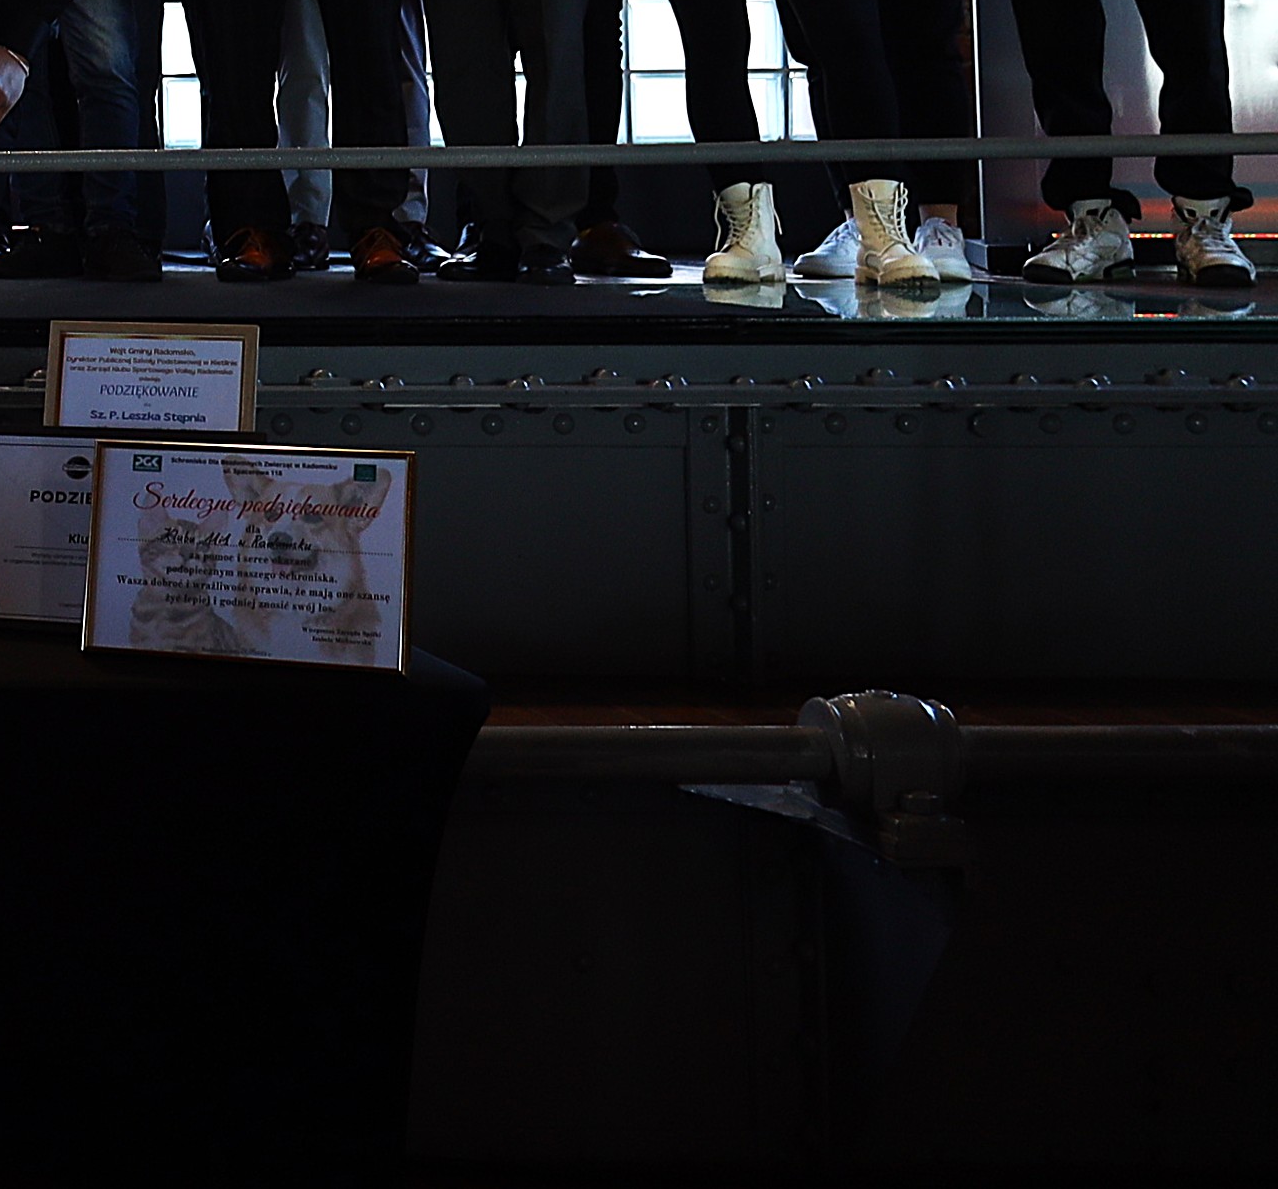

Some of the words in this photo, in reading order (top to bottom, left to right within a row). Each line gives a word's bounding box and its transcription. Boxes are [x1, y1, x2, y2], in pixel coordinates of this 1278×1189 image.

[99, 384, 199, 399] PODZIĘKOWANIE
[89, 409, 107, 420] Sz.
[109, 411, 120, 420] P.
[122, 410, 161, 422] Leszka
[133, 481, 242, 518] Serdeczne
[236, 493, 381, 522] podziękowania
[116, 574, 148, 586] Wasza
[308, 587, 333, 600] mają
